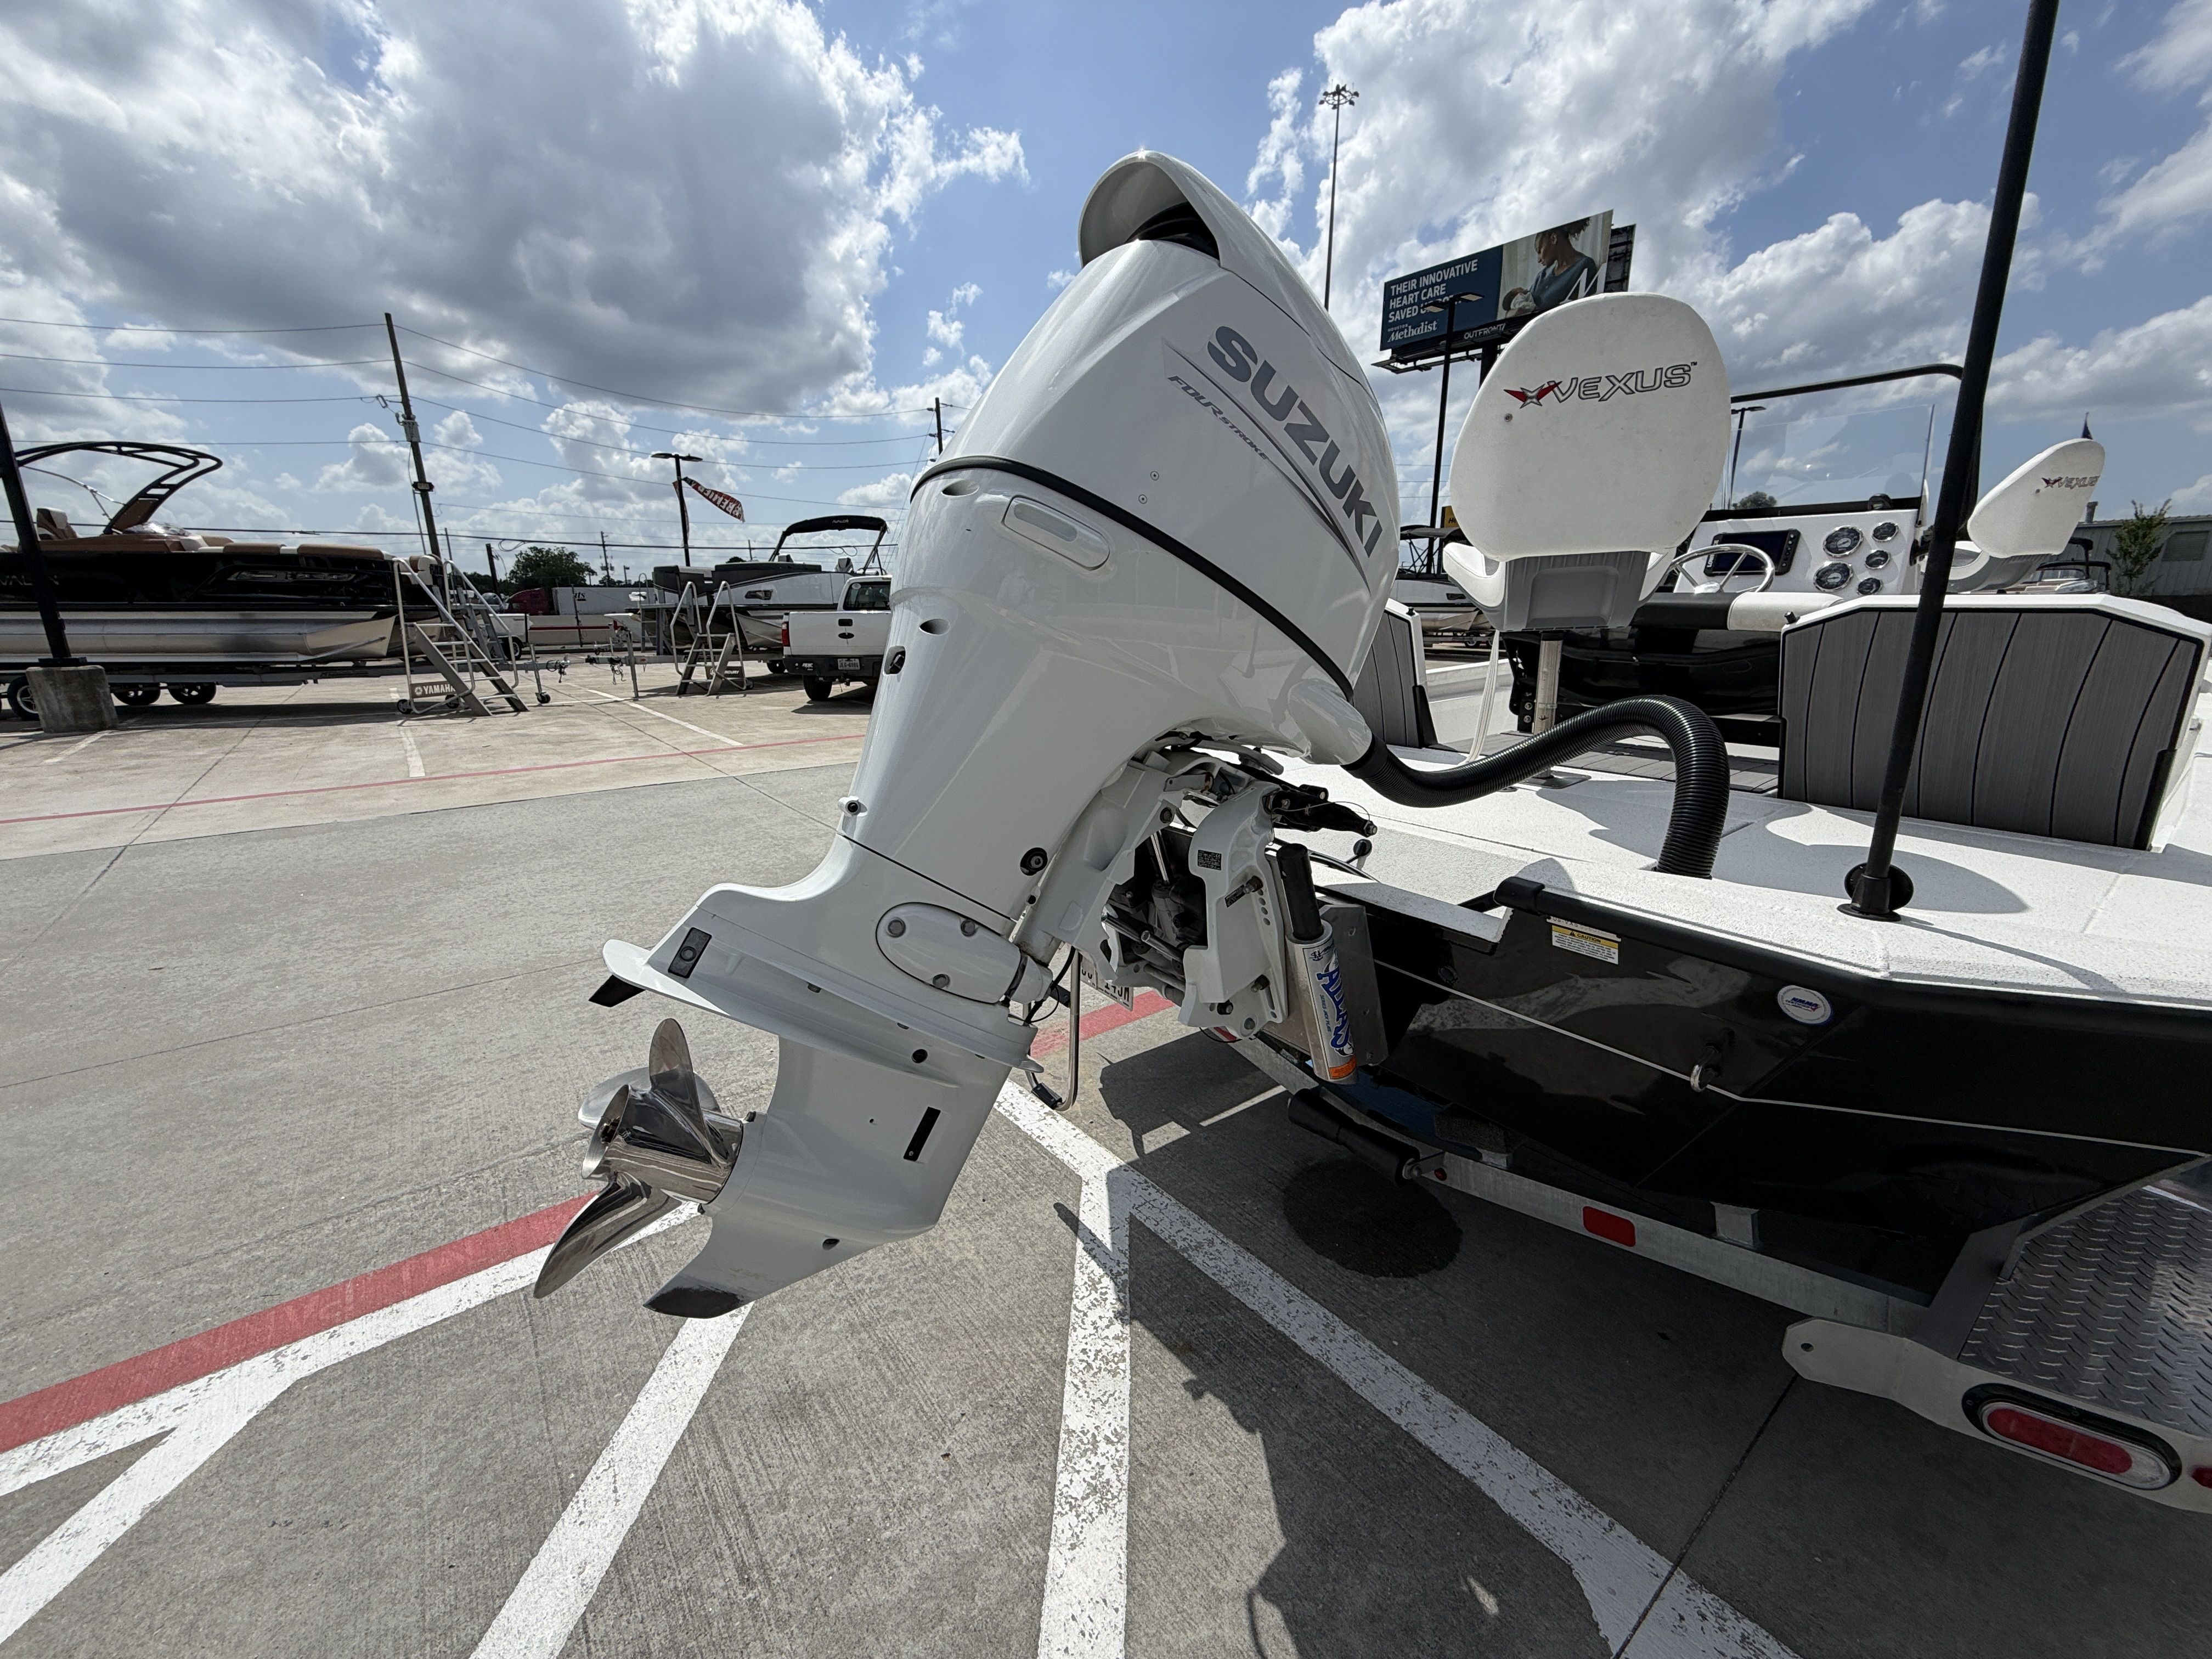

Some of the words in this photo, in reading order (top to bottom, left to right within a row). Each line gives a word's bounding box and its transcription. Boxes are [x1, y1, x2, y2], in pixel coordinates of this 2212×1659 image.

[1391, 279, 1417, 296] THEIR
[1419, 259, 1479, 287] INNOVATIVE
[1390, 291, 1420, 309] HEART
[1421, 283, 1447, 301] CARE
[1388, 305, 1419, 323] SAVED
[1387, 319, 1438, 342] Methodist
[1547, 364, 1691, 403] VEXUS
[1207, 326, 1383, 558] SUZUKI
[1577, 933, 1601, 943] CAUTION
